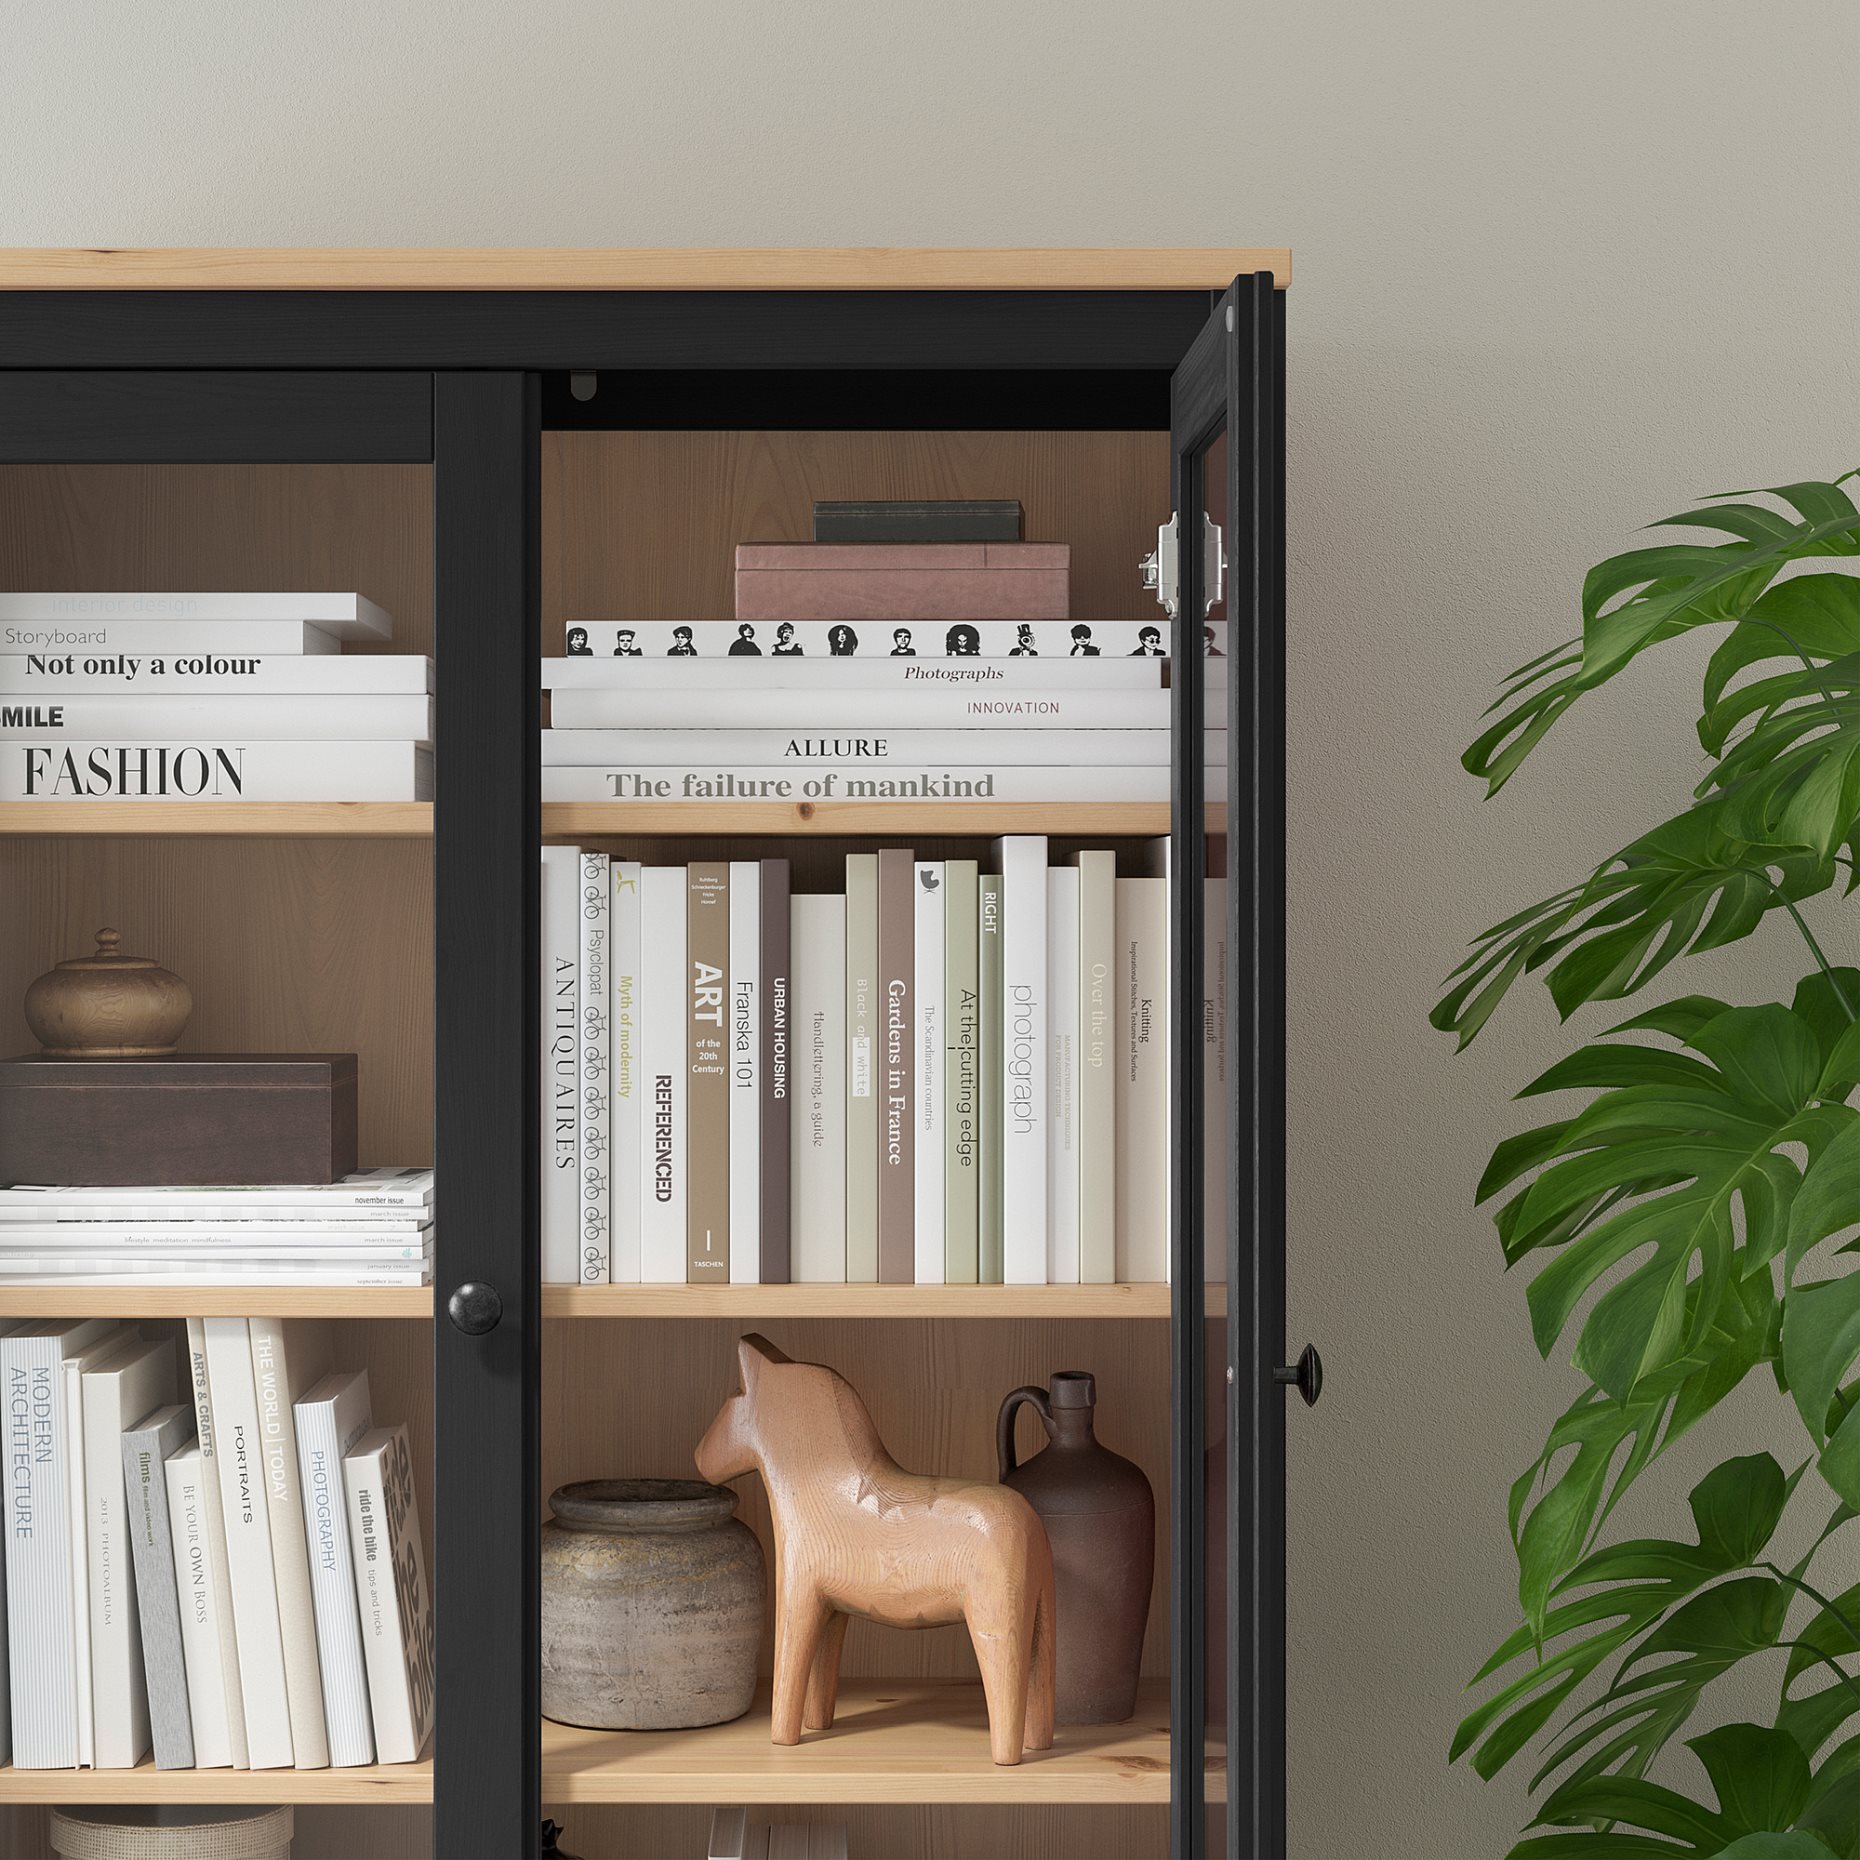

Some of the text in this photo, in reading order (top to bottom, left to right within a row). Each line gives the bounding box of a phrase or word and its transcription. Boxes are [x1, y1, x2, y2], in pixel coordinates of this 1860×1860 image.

[133, 594, 199, 616] design
[5, 628, 106, 648] Storyboard
[25, 654, 261, 680] Not only a colour
[903, 664, 1005, 683] Photographs
[0, 706, 64, 727] MILE
[967, 702, 1060, 714] INNOVATION
[22, 746, 246, 796] FASHION
[783, 738, 889, 757] ALLURE
[606, 773, 995, 798] The failure of mankind
[984, 892, 997, 934] RIGHT
[588, 928, 604, 996] Psyclopat
[1129, 941, 1138, 982] Inspirational
[694, 961, 723, 1027] ART
[1088, 963, 1108, 1068] Over the top
[616, 975, 633, 1099] Myth of modernity
[696, 1039, 720, 1048] of the
[736, 981, 753, 1090] Franska 101
[773, 977, 786, 1099] URBAN HOUSING
[857, 978, 868, 1095] Black and white
[1129, 1011, 1138, 1039] Textures
[1139, 998, 1152, 1044] Knitting
[550, 956, 575, 1170] ANTIQUAIRES
[692, 1064, 724, 1075] Century
[698, 1051, 718, 1061] 20th
[924, 1005, 936, 1132] The Scandinavian countries
[1008, 985, 1033, 1135] photograph
[1129, 1040, 1138, 1053] and
[1129, 1054, 1138, 1082] Surfaces
[888, 980, 907, 1166] Gardens in France
[956, 989, 978, 1167] At the cutting edge
[811, 1113, 825, 1148] guide
[813, 1102, 822, 1110] a
[655, 1074, 672, 1203] REFERENCED
[355, 1196, 404, 1205] november issue
[33, 1366, 53, 1464] MODERN
[193, 1352, 213, 1458] ARTS & CRAFTS
[258, 1335, 288, 1503] THE WORLD TODAY
[10, 1366, 34, 1539] ARCHITECTURE
[139, 1451, 151, 1484] films
[233, 1425, 253, 1525] PORTRAITS
[144, 1512, 153, 1530] video
[311, 1450, 336, 1572] PHOTOGRAPHY
[99, 1497, 112, 1627] 2013 PHOTOALBUM
[183, 1484, 208, 1624] BE YOUR OWN BOSS
[358, 1489, 383, 1637] ride the bike tips and tricks
